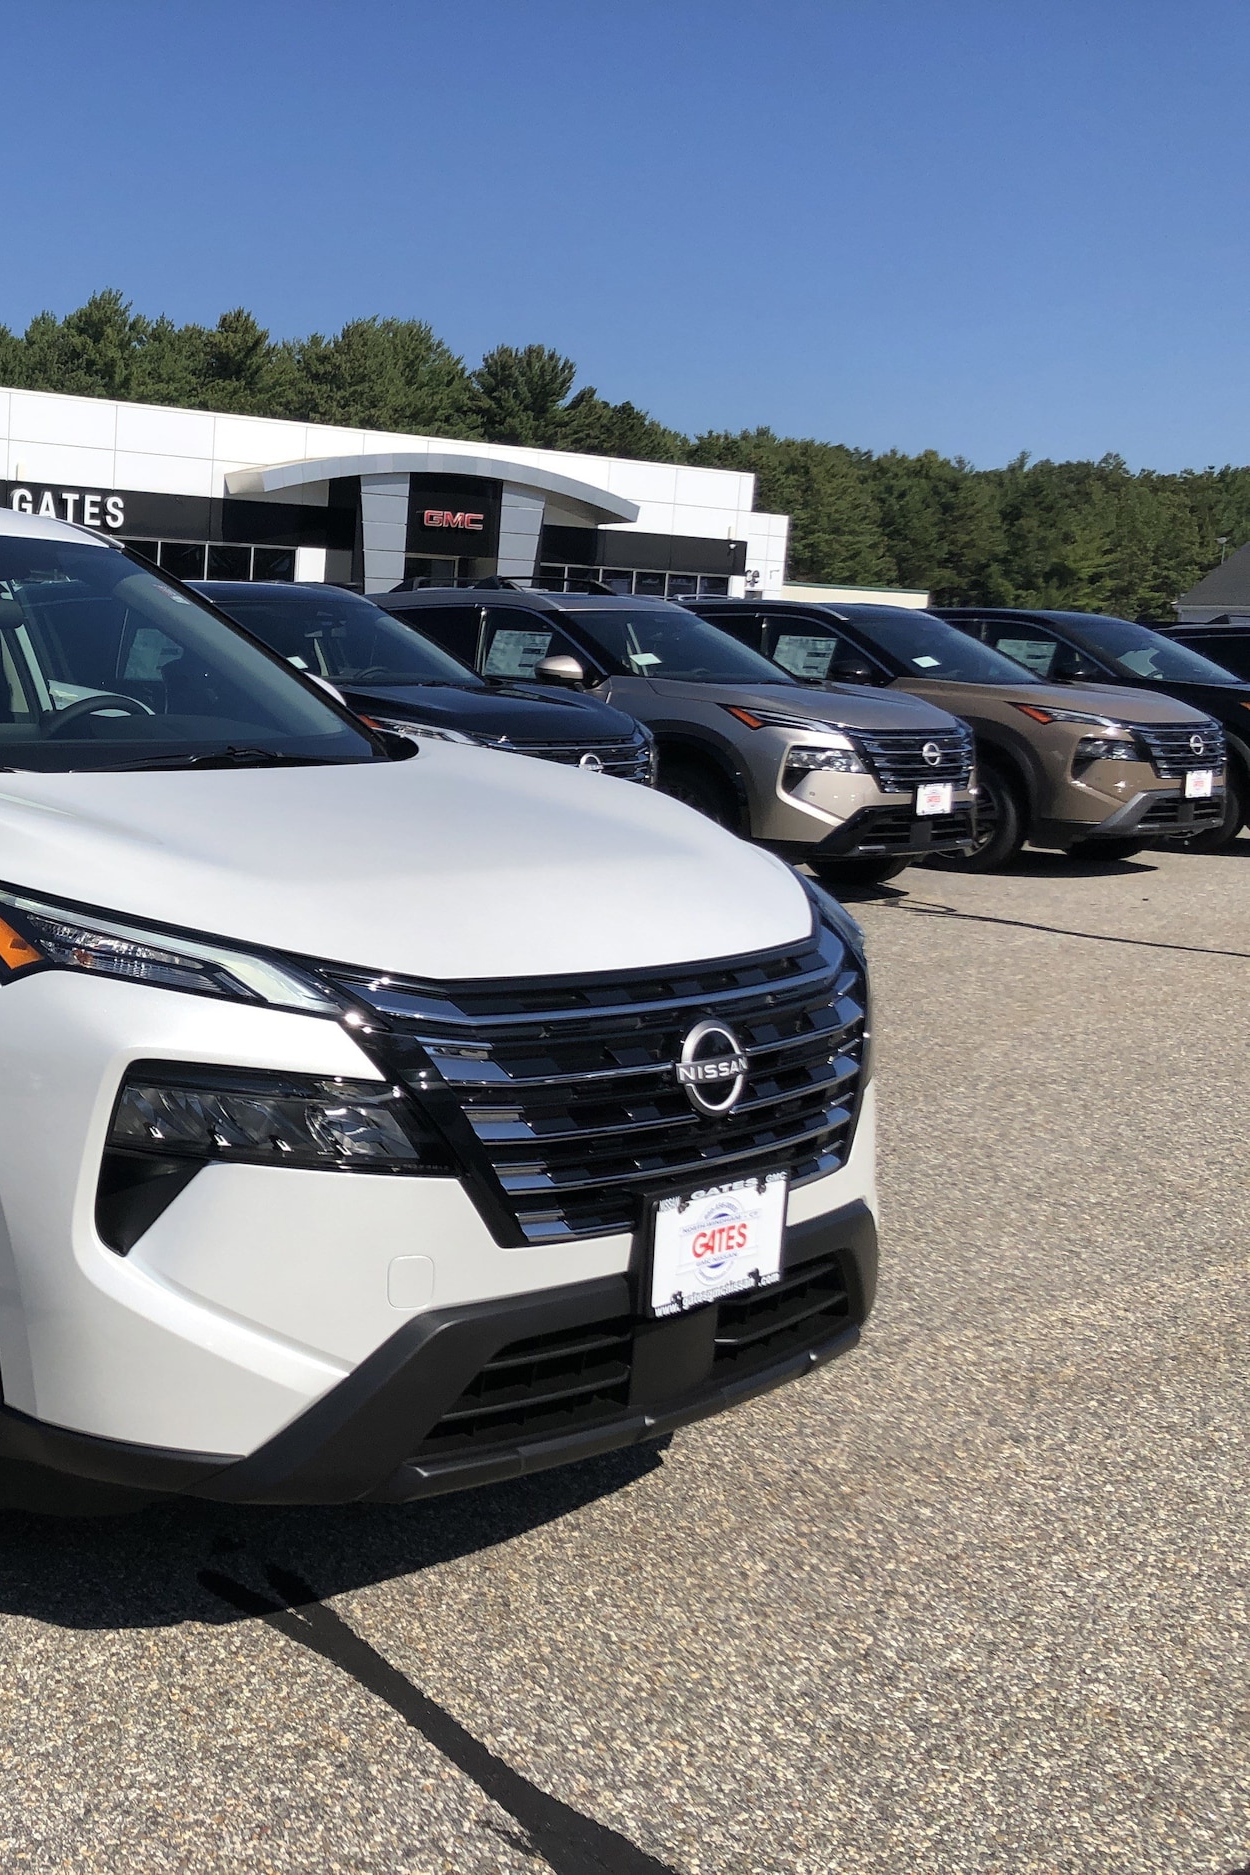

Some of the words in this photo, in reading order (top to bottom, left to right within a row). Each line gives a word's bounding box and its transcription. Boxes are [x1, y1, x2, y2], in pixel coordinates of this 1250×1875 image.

[11, 488, 125, 529] GATES
[424, 509, 484, 531] GMC
[678, 1056, 749, 1081] NISSAN
[690, 1177, 759, 1200] GATES
[692, 1222, 748, 1259] GATES
